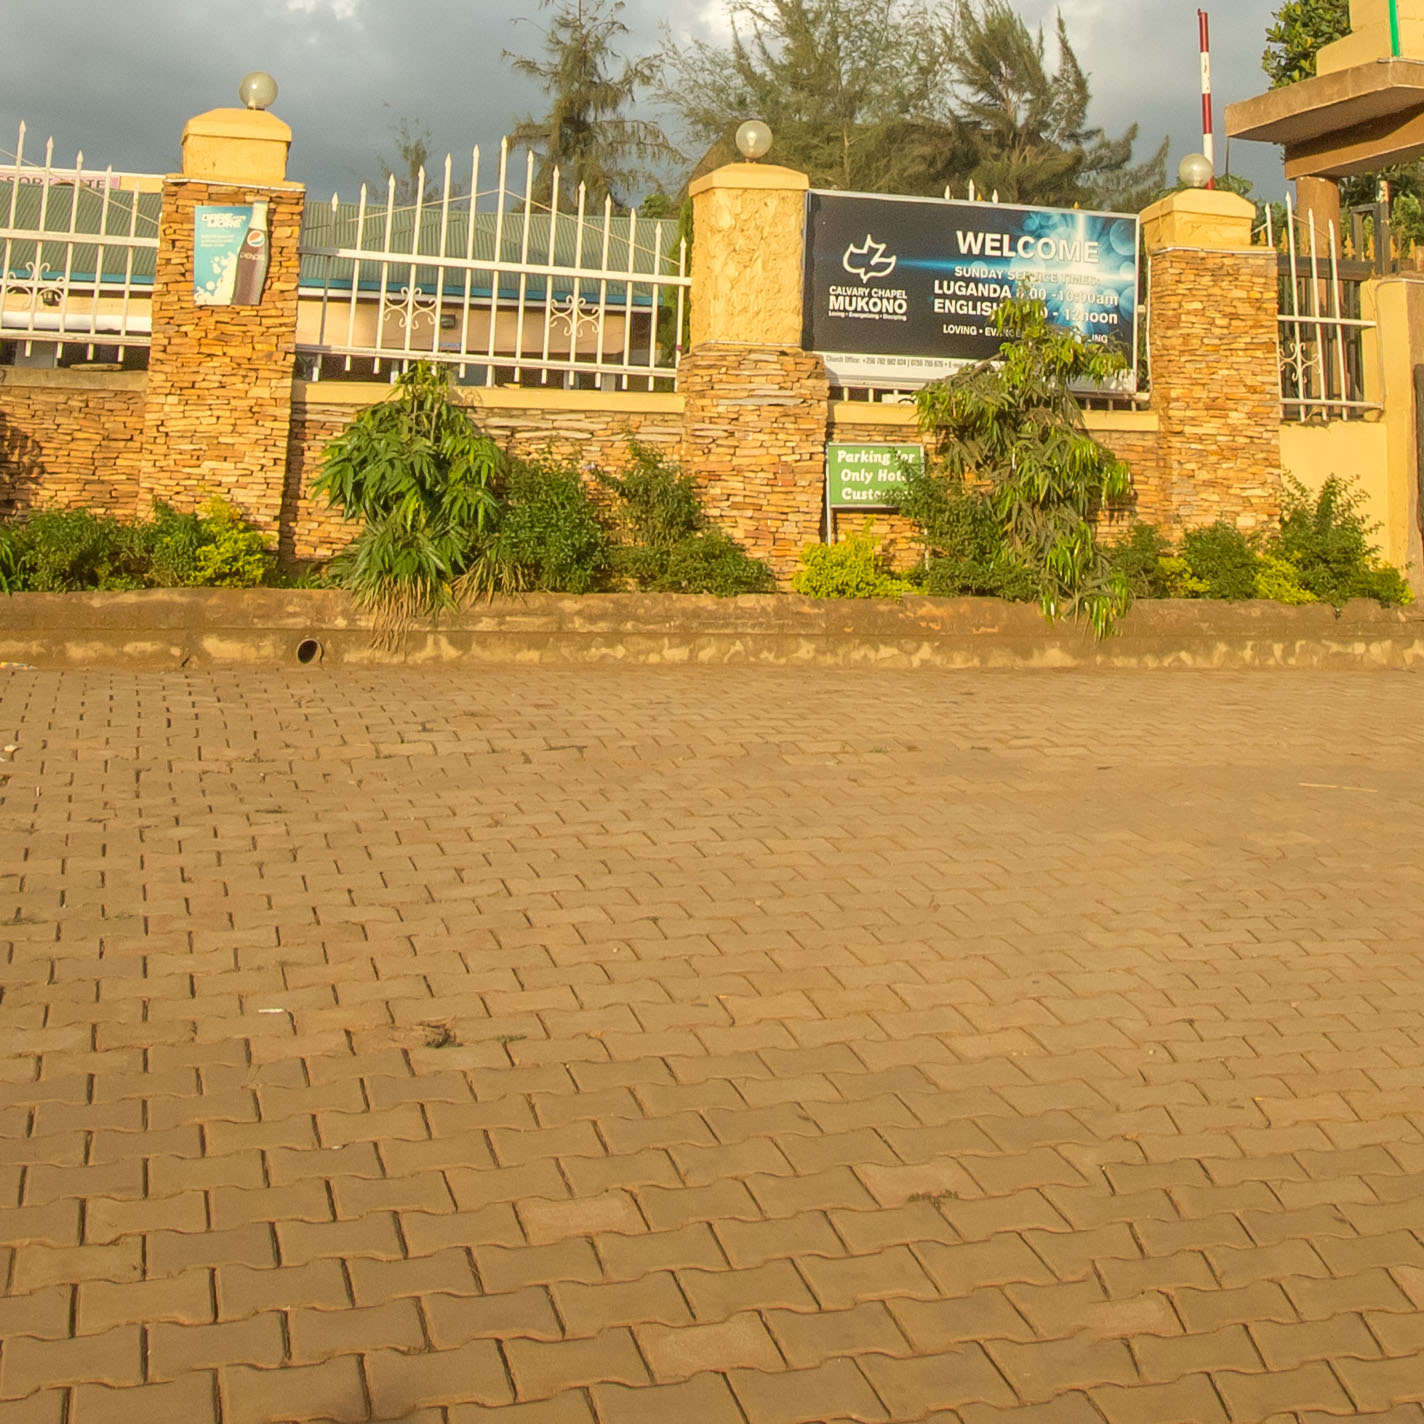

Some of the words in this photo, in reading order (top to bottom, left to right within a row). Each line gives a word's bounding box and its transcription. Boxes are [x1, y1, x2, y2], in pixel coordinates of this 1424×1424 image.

[956, 230, 1099, 263] WELCOME
[955, 266, 1004, 279] SUNDAY
[829, 285, 870, 297] CALVARY
[871, 288, 908, 299] CHAPEL
[934, 279, 1012, 298] LUGANDA
[828, 295, 908, 314] MUKONO
[943, 324, 978, 336] LOVING
[837, 449, 891, 466] Parking
[841, 468, 874, 484] Only
[878, 468, 914, 482] Hot
